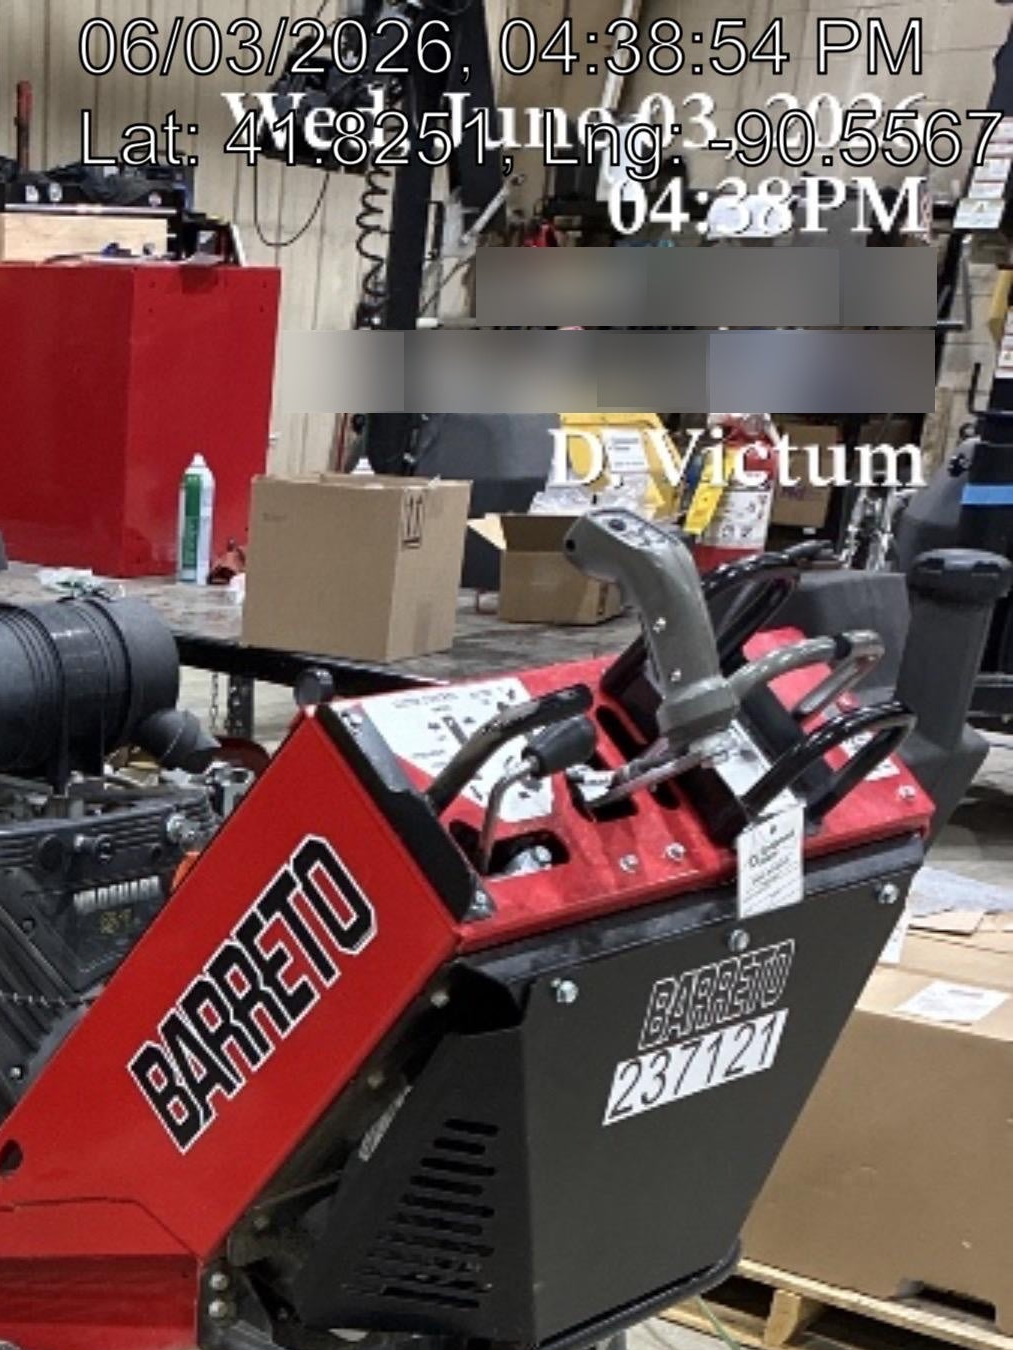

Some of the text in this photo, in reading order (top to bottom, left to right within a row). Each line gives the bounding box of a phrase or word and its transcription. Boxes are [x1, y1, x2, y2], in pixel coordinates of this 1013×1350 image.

[127, 834, 378, 1155] BARRETO
[638, 937, 796, 1051] BARRETO
[607, 1013, 778, 1116] 237121
